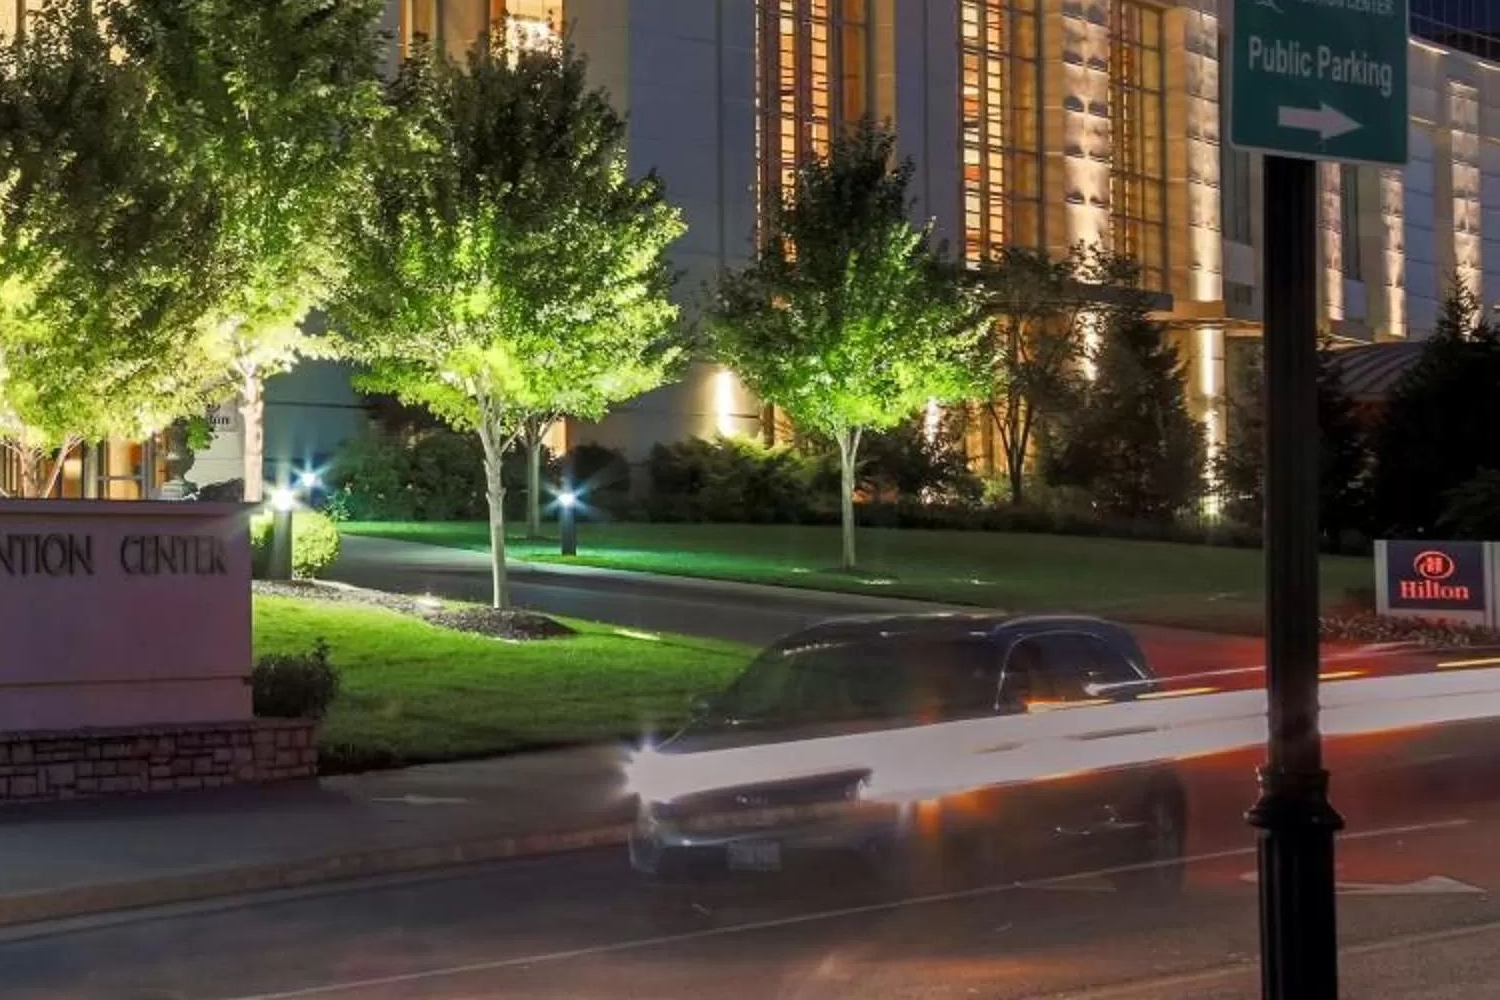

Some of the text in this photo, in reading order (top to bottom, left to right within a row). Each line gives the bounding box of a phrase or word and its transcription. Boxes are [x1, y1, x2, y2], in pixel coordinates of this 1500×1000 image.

[1248, 35, 1393, 97] Public Parking
[120, 534, 228, 577] CENTER
